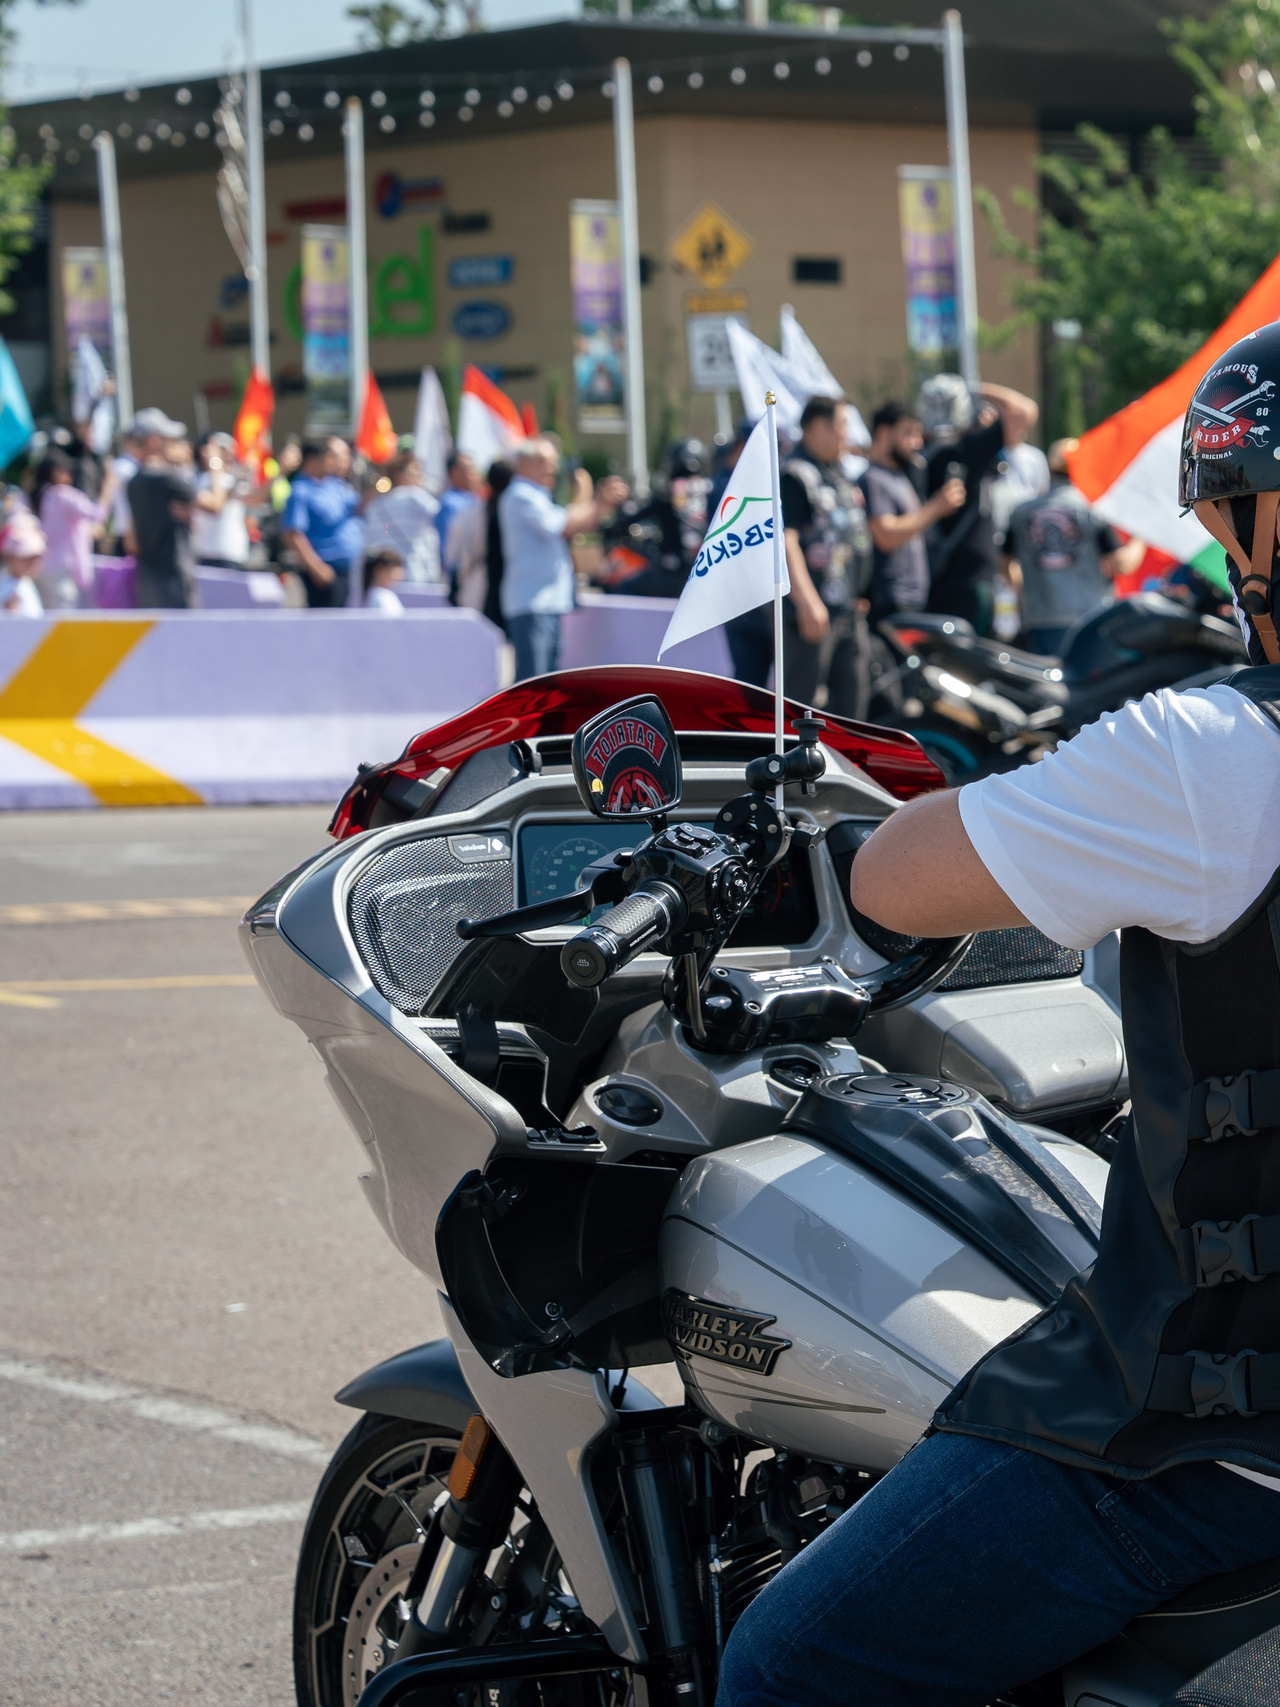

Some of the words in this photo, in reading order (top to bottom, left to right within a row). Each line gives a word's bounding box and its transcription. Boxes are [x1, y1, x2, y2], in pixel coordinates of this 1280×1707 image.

[1255, 406, 1270, 417] 80
[1196, 423, 1242, 444] RIDER
[1201, 450, 1233, 460] ORIGINAL
